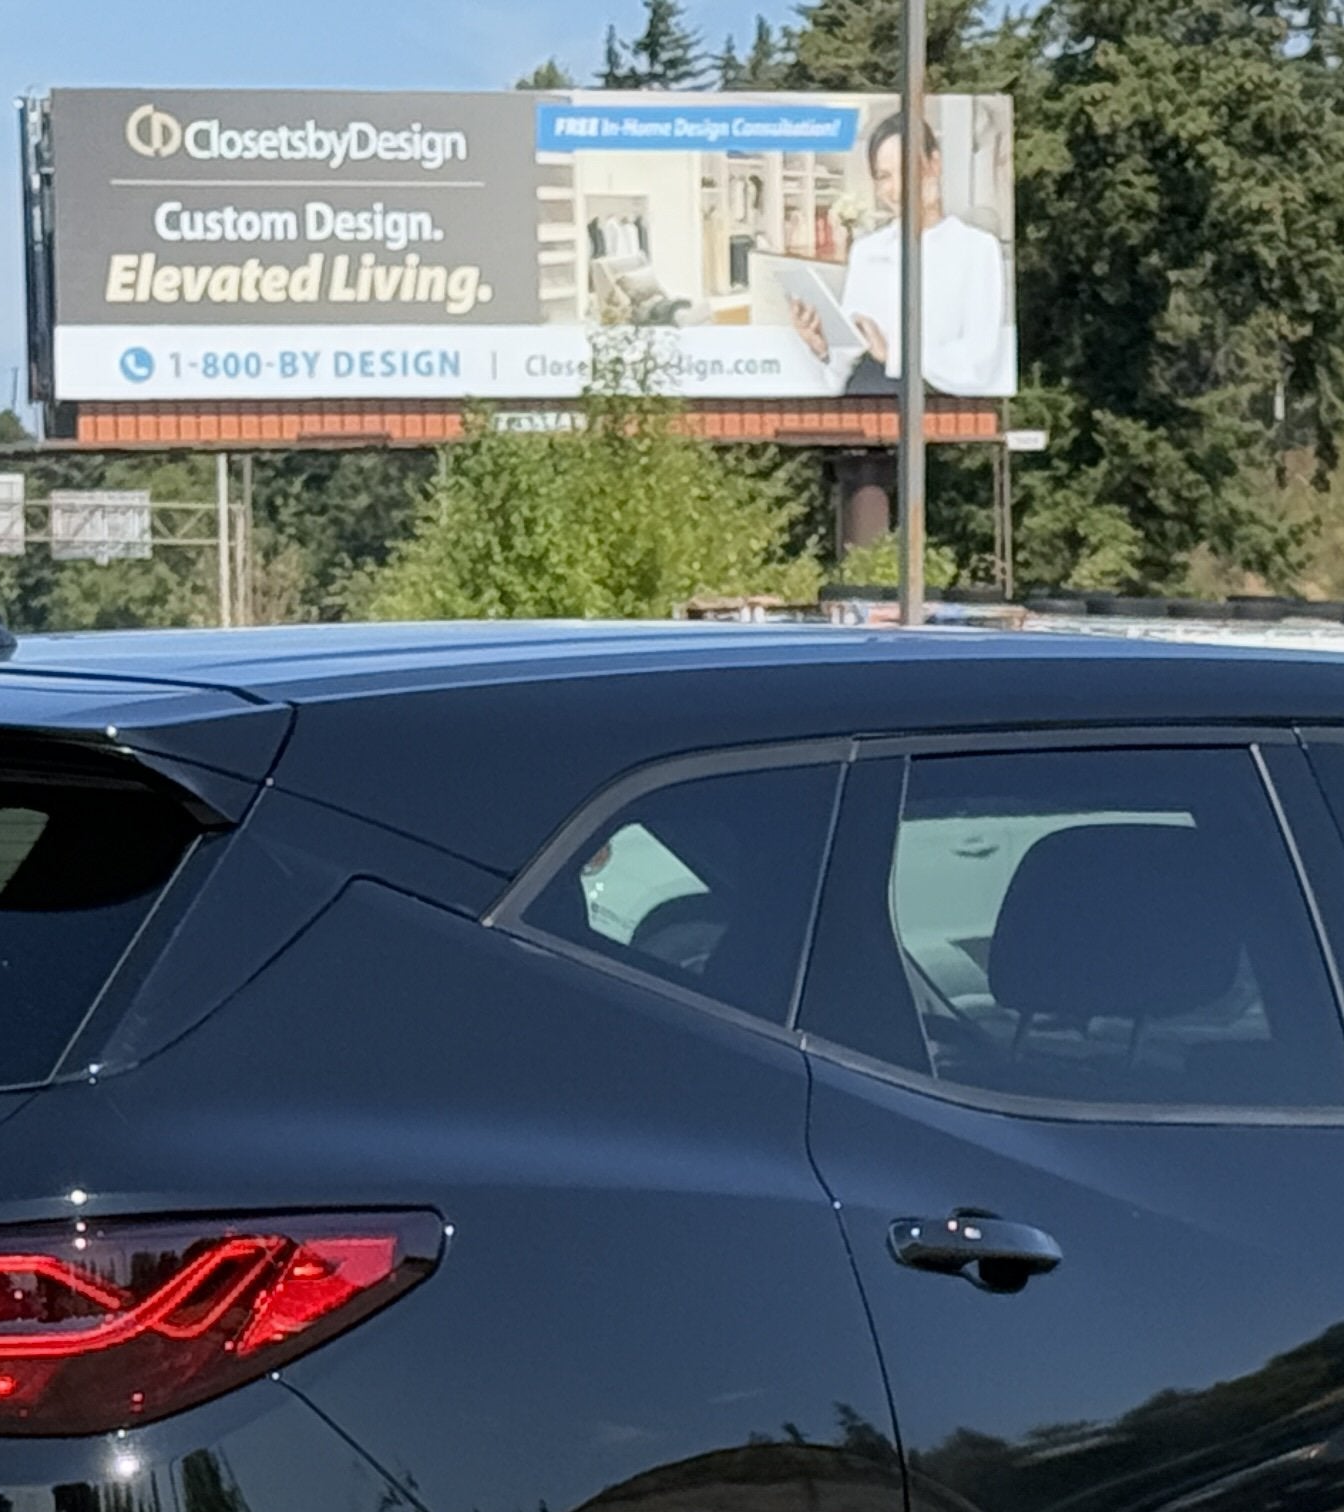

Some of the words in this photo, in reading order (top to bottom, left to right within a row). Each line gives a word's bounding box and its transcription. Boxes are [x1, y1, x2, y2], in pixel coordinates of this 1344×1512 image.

[184, 119, 468, 169] ClosetsbyDesign
[554, 117, 600, 137] FREE
[601, 117, 672, 137] In-Home
[674, 117, 729, 142] Design
[154, 201, 298, 242] Custom
[305, 201, 445, 251] Design.
[106, 252, 324, 303] Elevated
[329, 252, 493, 315] Living.
[168, 351, 323, 379] 1-800-BY
[333, 350, 462, 379] DESIGN
